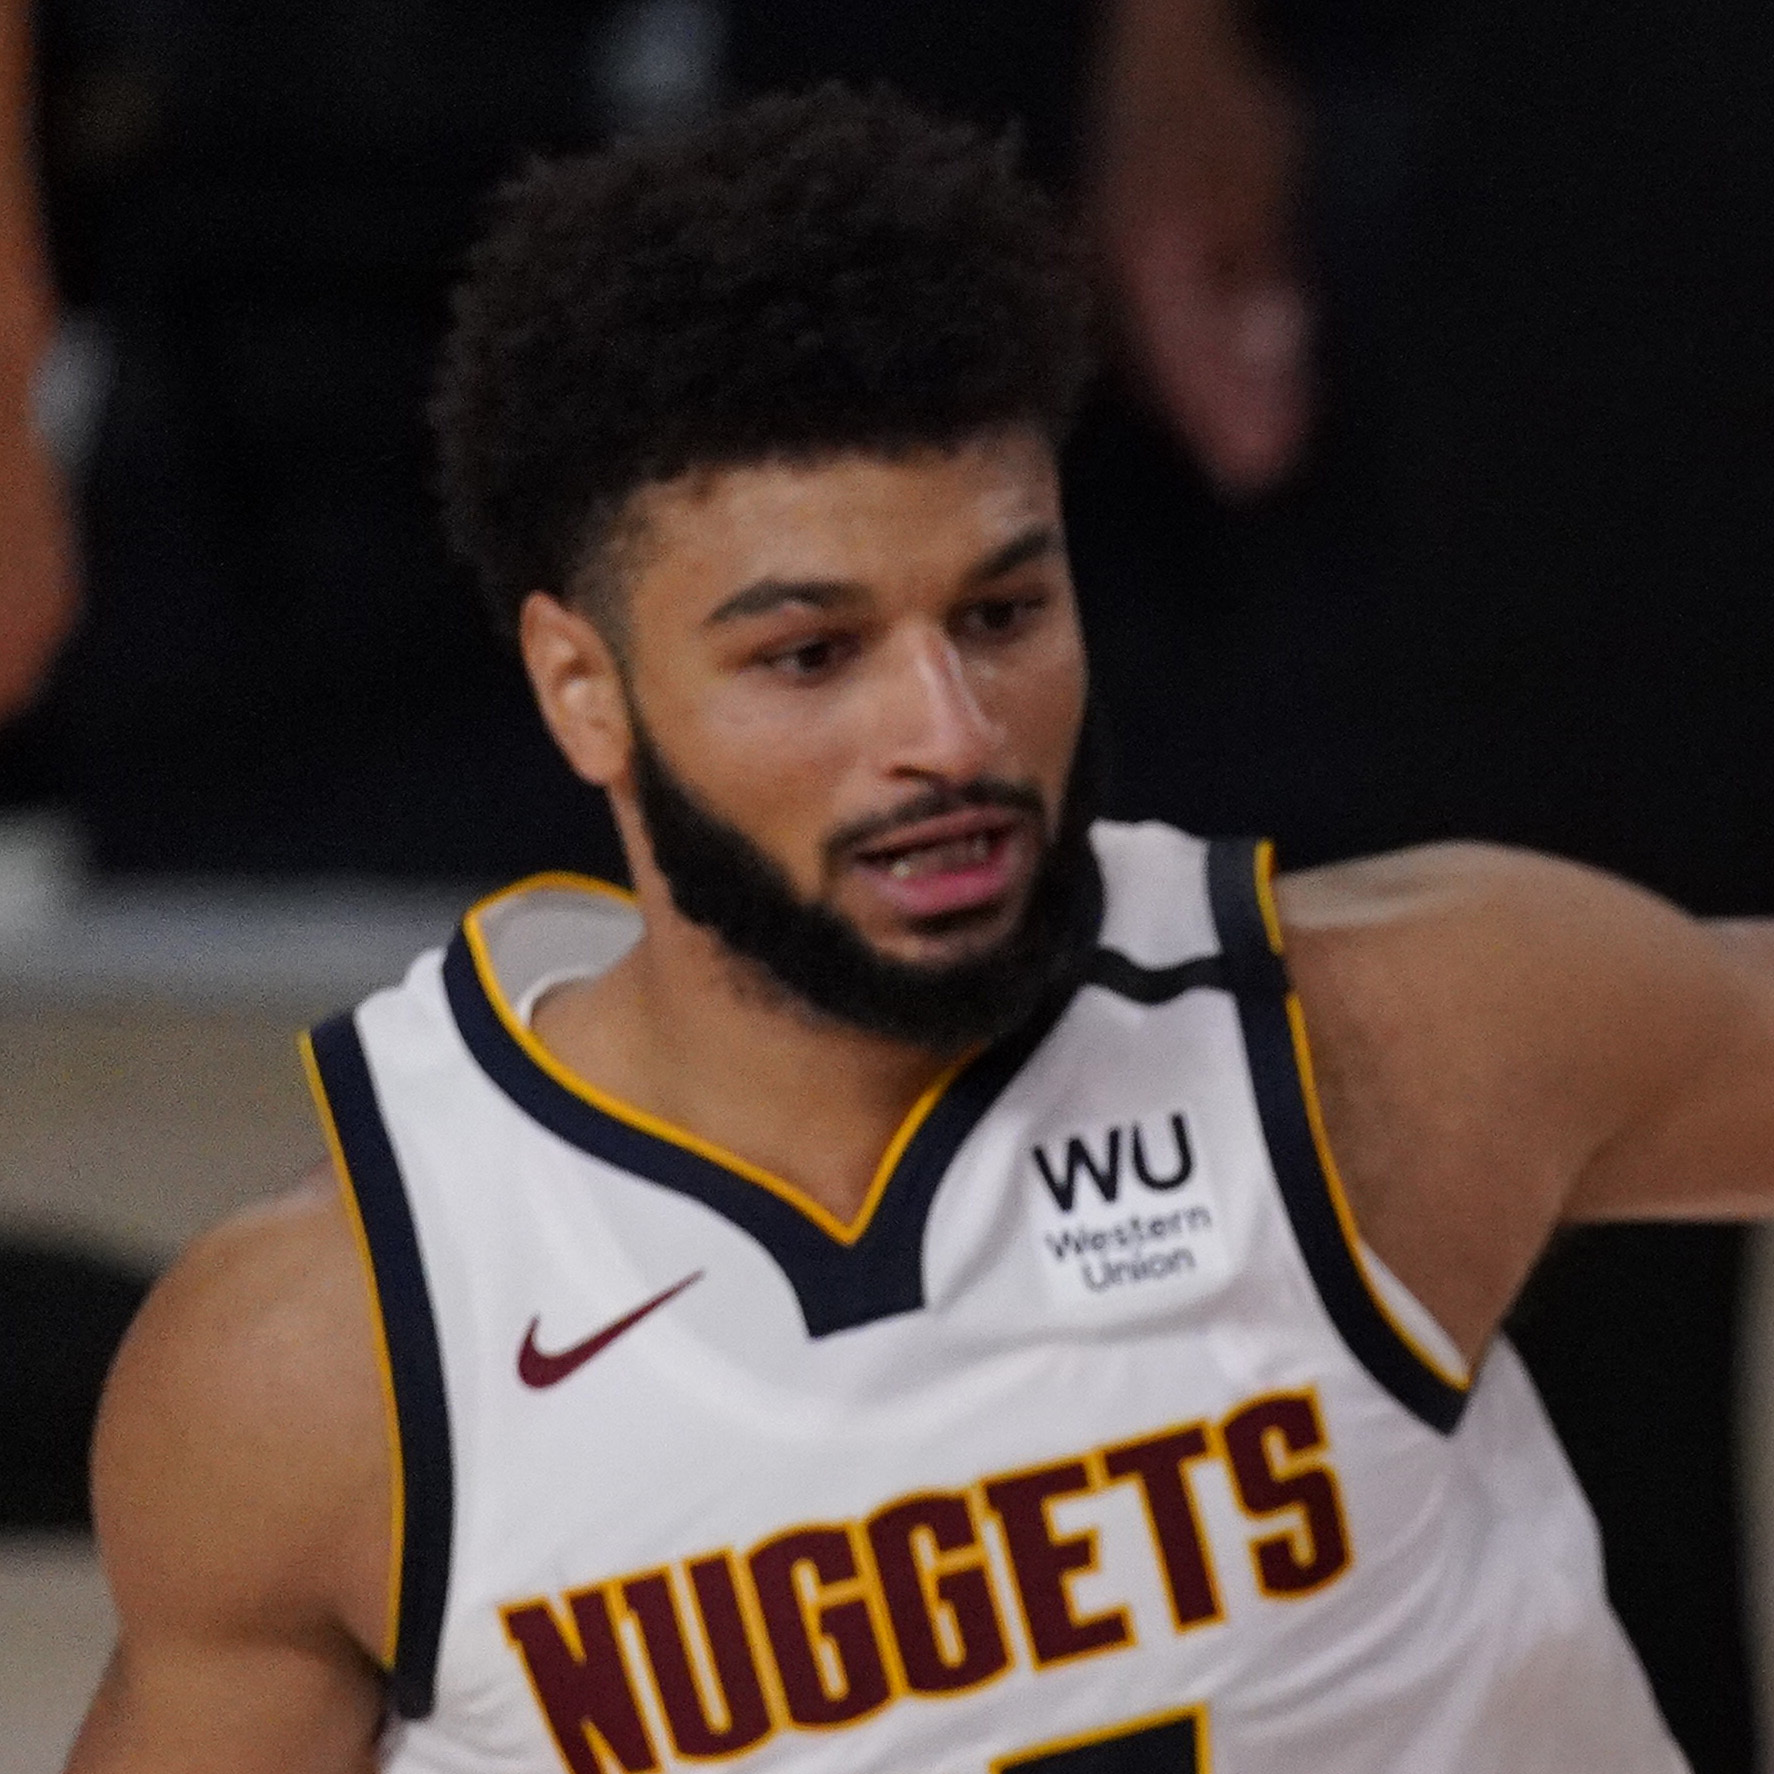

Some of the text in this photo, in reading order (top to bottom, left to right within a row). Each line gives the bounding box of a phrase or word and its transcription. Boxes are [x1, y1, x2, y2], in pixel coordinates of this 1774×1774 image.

[1032, 1112, 1193, 1215] WU
[1046, 1206, 1212, 1261] Western
[1081, 1248, 1196, 1293] Union
